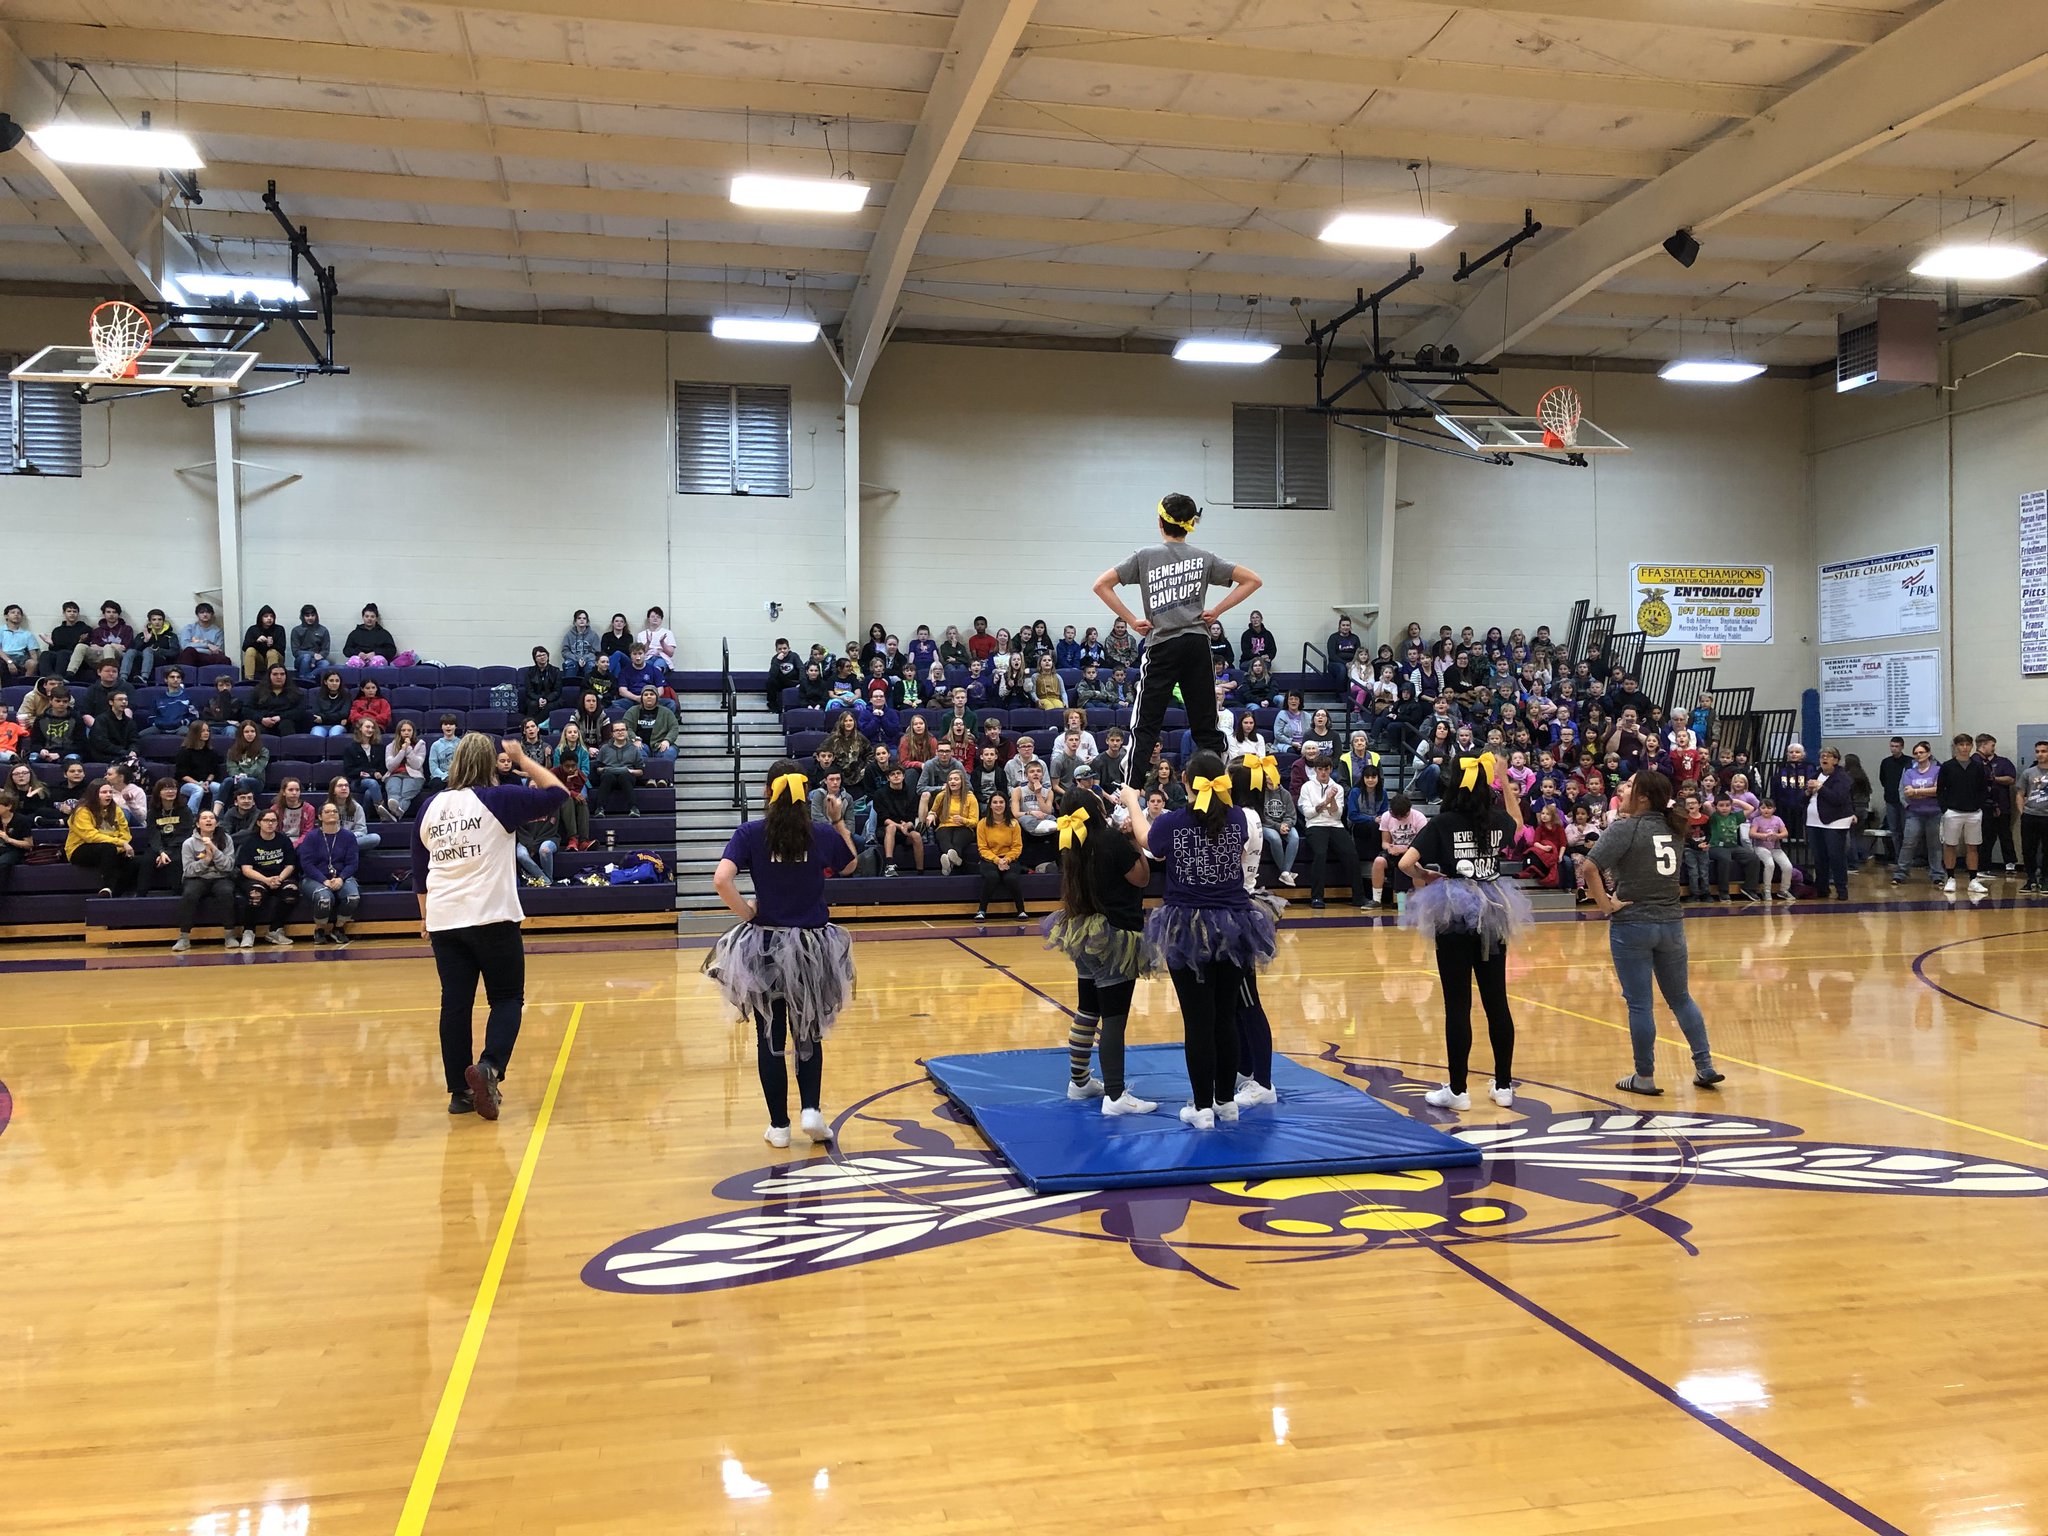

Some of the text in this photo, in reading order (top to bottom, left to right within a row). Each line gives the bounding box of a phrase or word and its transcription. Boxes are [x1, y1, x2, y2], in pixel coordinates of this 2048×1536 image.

[2021, 545, 2046, 555] Friedman
[1148, 557, 1203, 583] REMEMBER
[1641, 569, 1761, 579] FFA STATE CHAMPIONS
[1834, 559, 1920, 580] STATE CHAMPIONS
[2021, 567, 2046, 577] Pearson
[1148, 570, 1203, 593] THAT GUY THAT
[1150, 588, 1178, 609] GAVE
[1180, 582, 1202, 600] UP?
[1674, 587, 1763, 598] ENTOMOLOGY
[1909, 585, 1934, 597] FBLA
[2022, 588, 2046, 598] Pitts
[1697, 607, 1730, 616] PLACE
[1734, 607, 1760, 616] 2009
[1705, 645, 1719, 656] EXIT
[460, 816, 482, 831] DAY
[1231, 824, 1241, 832] TO
[1173, 836, 1189, 849] BE
[1218, 832, 1241, 846] BEST
[1490, 830, 1503, 847] UP
[432, 844, 481, 861] HORNET!
[1174, 849, 1191, 858] ON
[1194, 846, 1208, 856] THE
[1653, 834, 1677, 876] 5
[1214, 854, 1230, 864] TO
[1197, 864, 1220, 877] BEST
